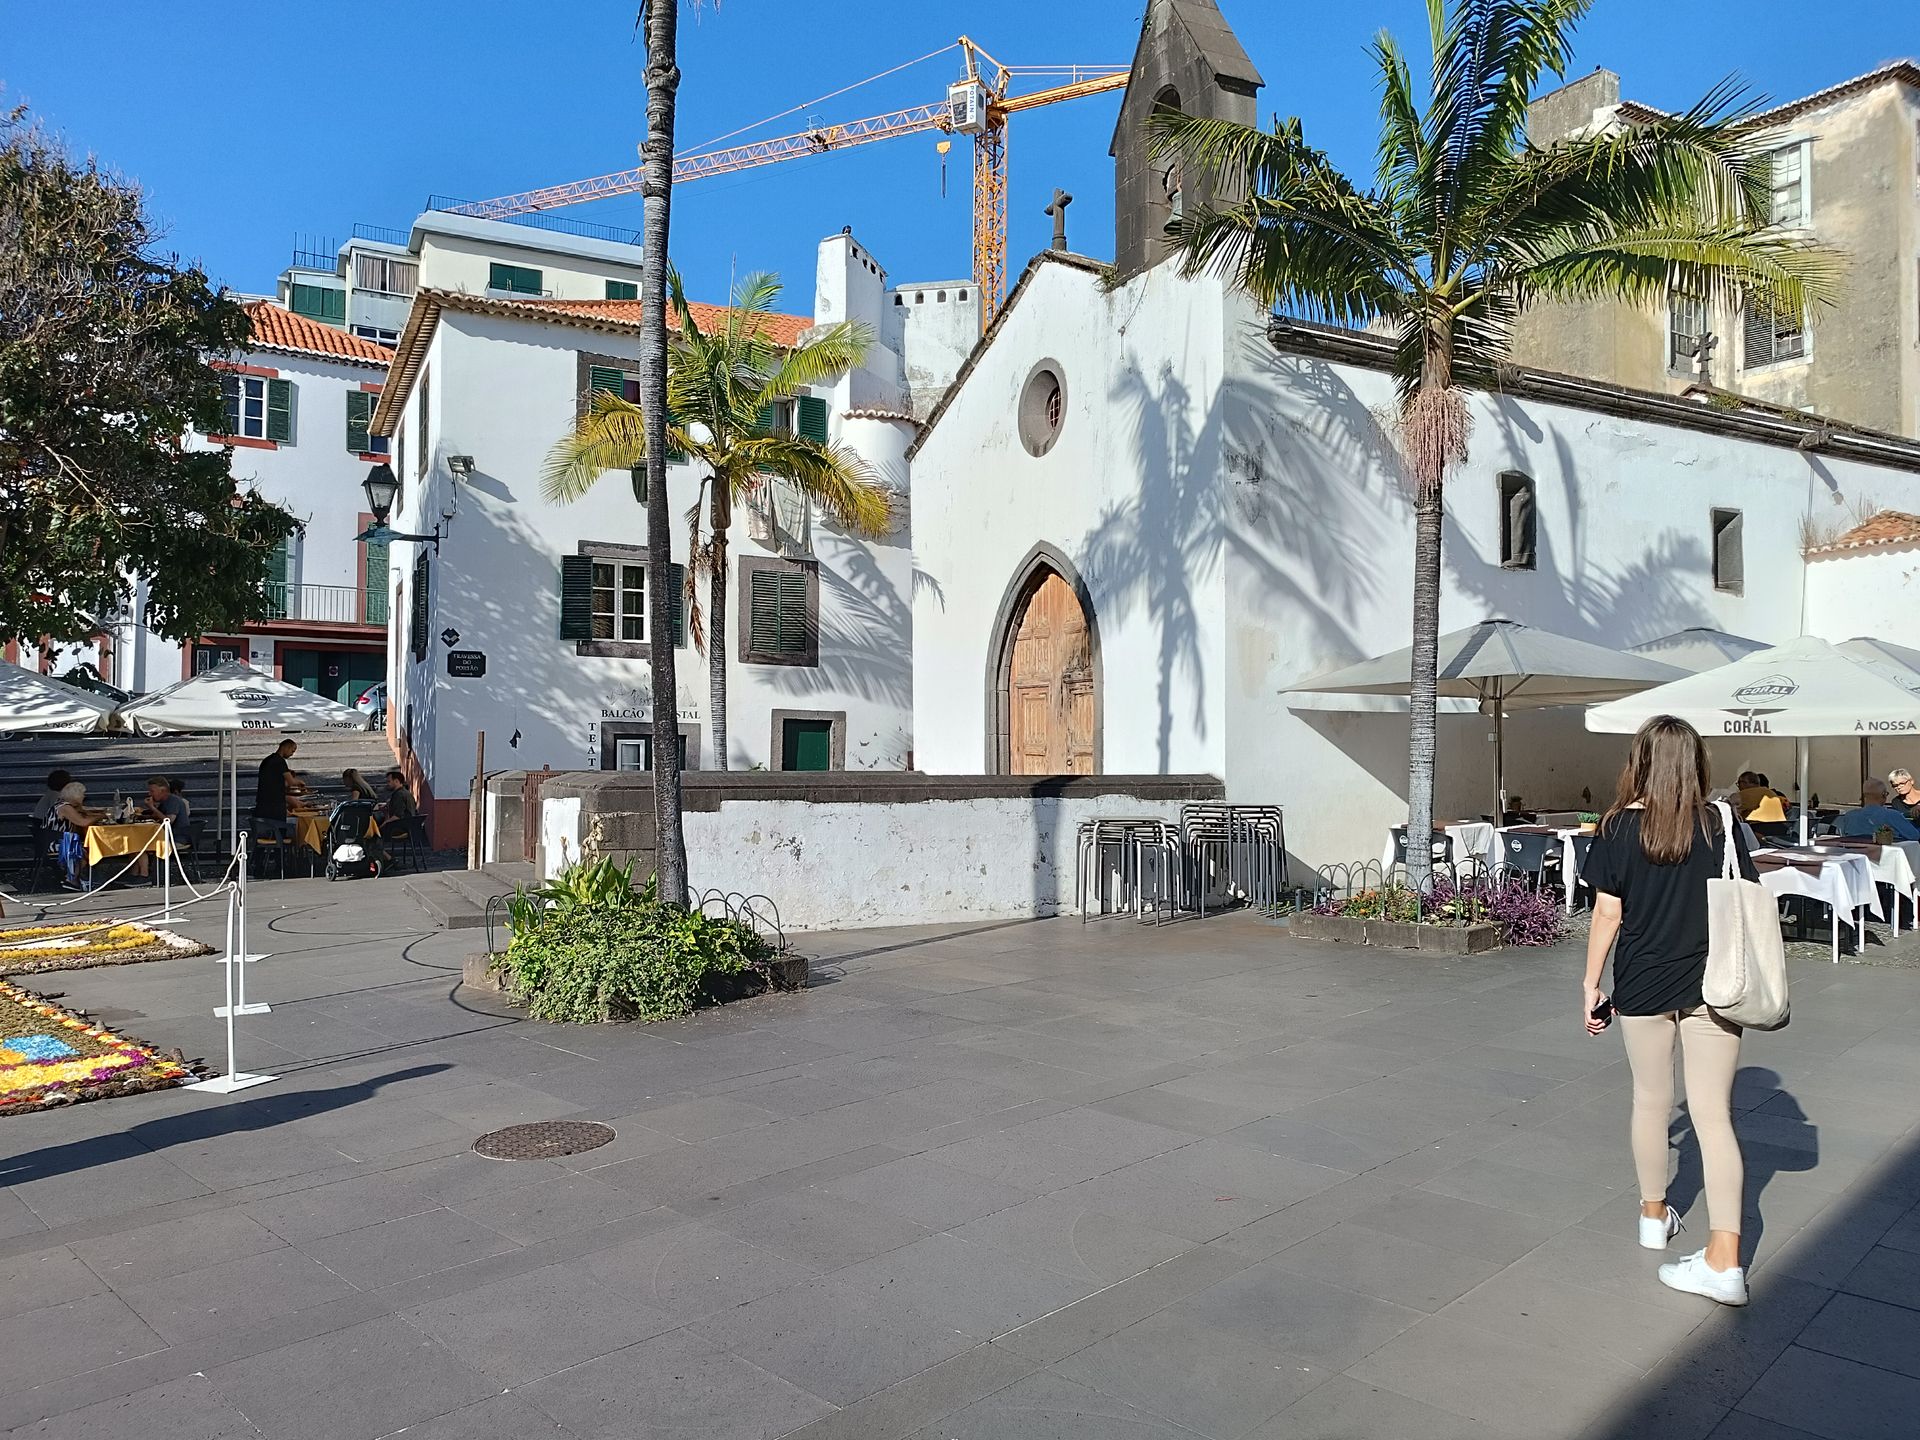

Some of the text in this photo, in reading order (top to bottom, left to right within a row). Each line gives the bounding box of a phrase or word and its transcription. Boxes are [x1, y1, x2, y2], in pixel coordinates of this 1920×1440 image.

[1741, 685, 1790, 696] CORAL
[232, 693, 267, 701] CORAL
[601, 708, 701, 720] BALCÃO STAL
[242, 720, 275, 729] CORAL
[331, 722, 358, 730] NOSSA
[1723, 720, 1771, 734] CORAL
[1855, 719, 1917, 731] À NOSSA
[588, 723, 597, 771] TEAT
